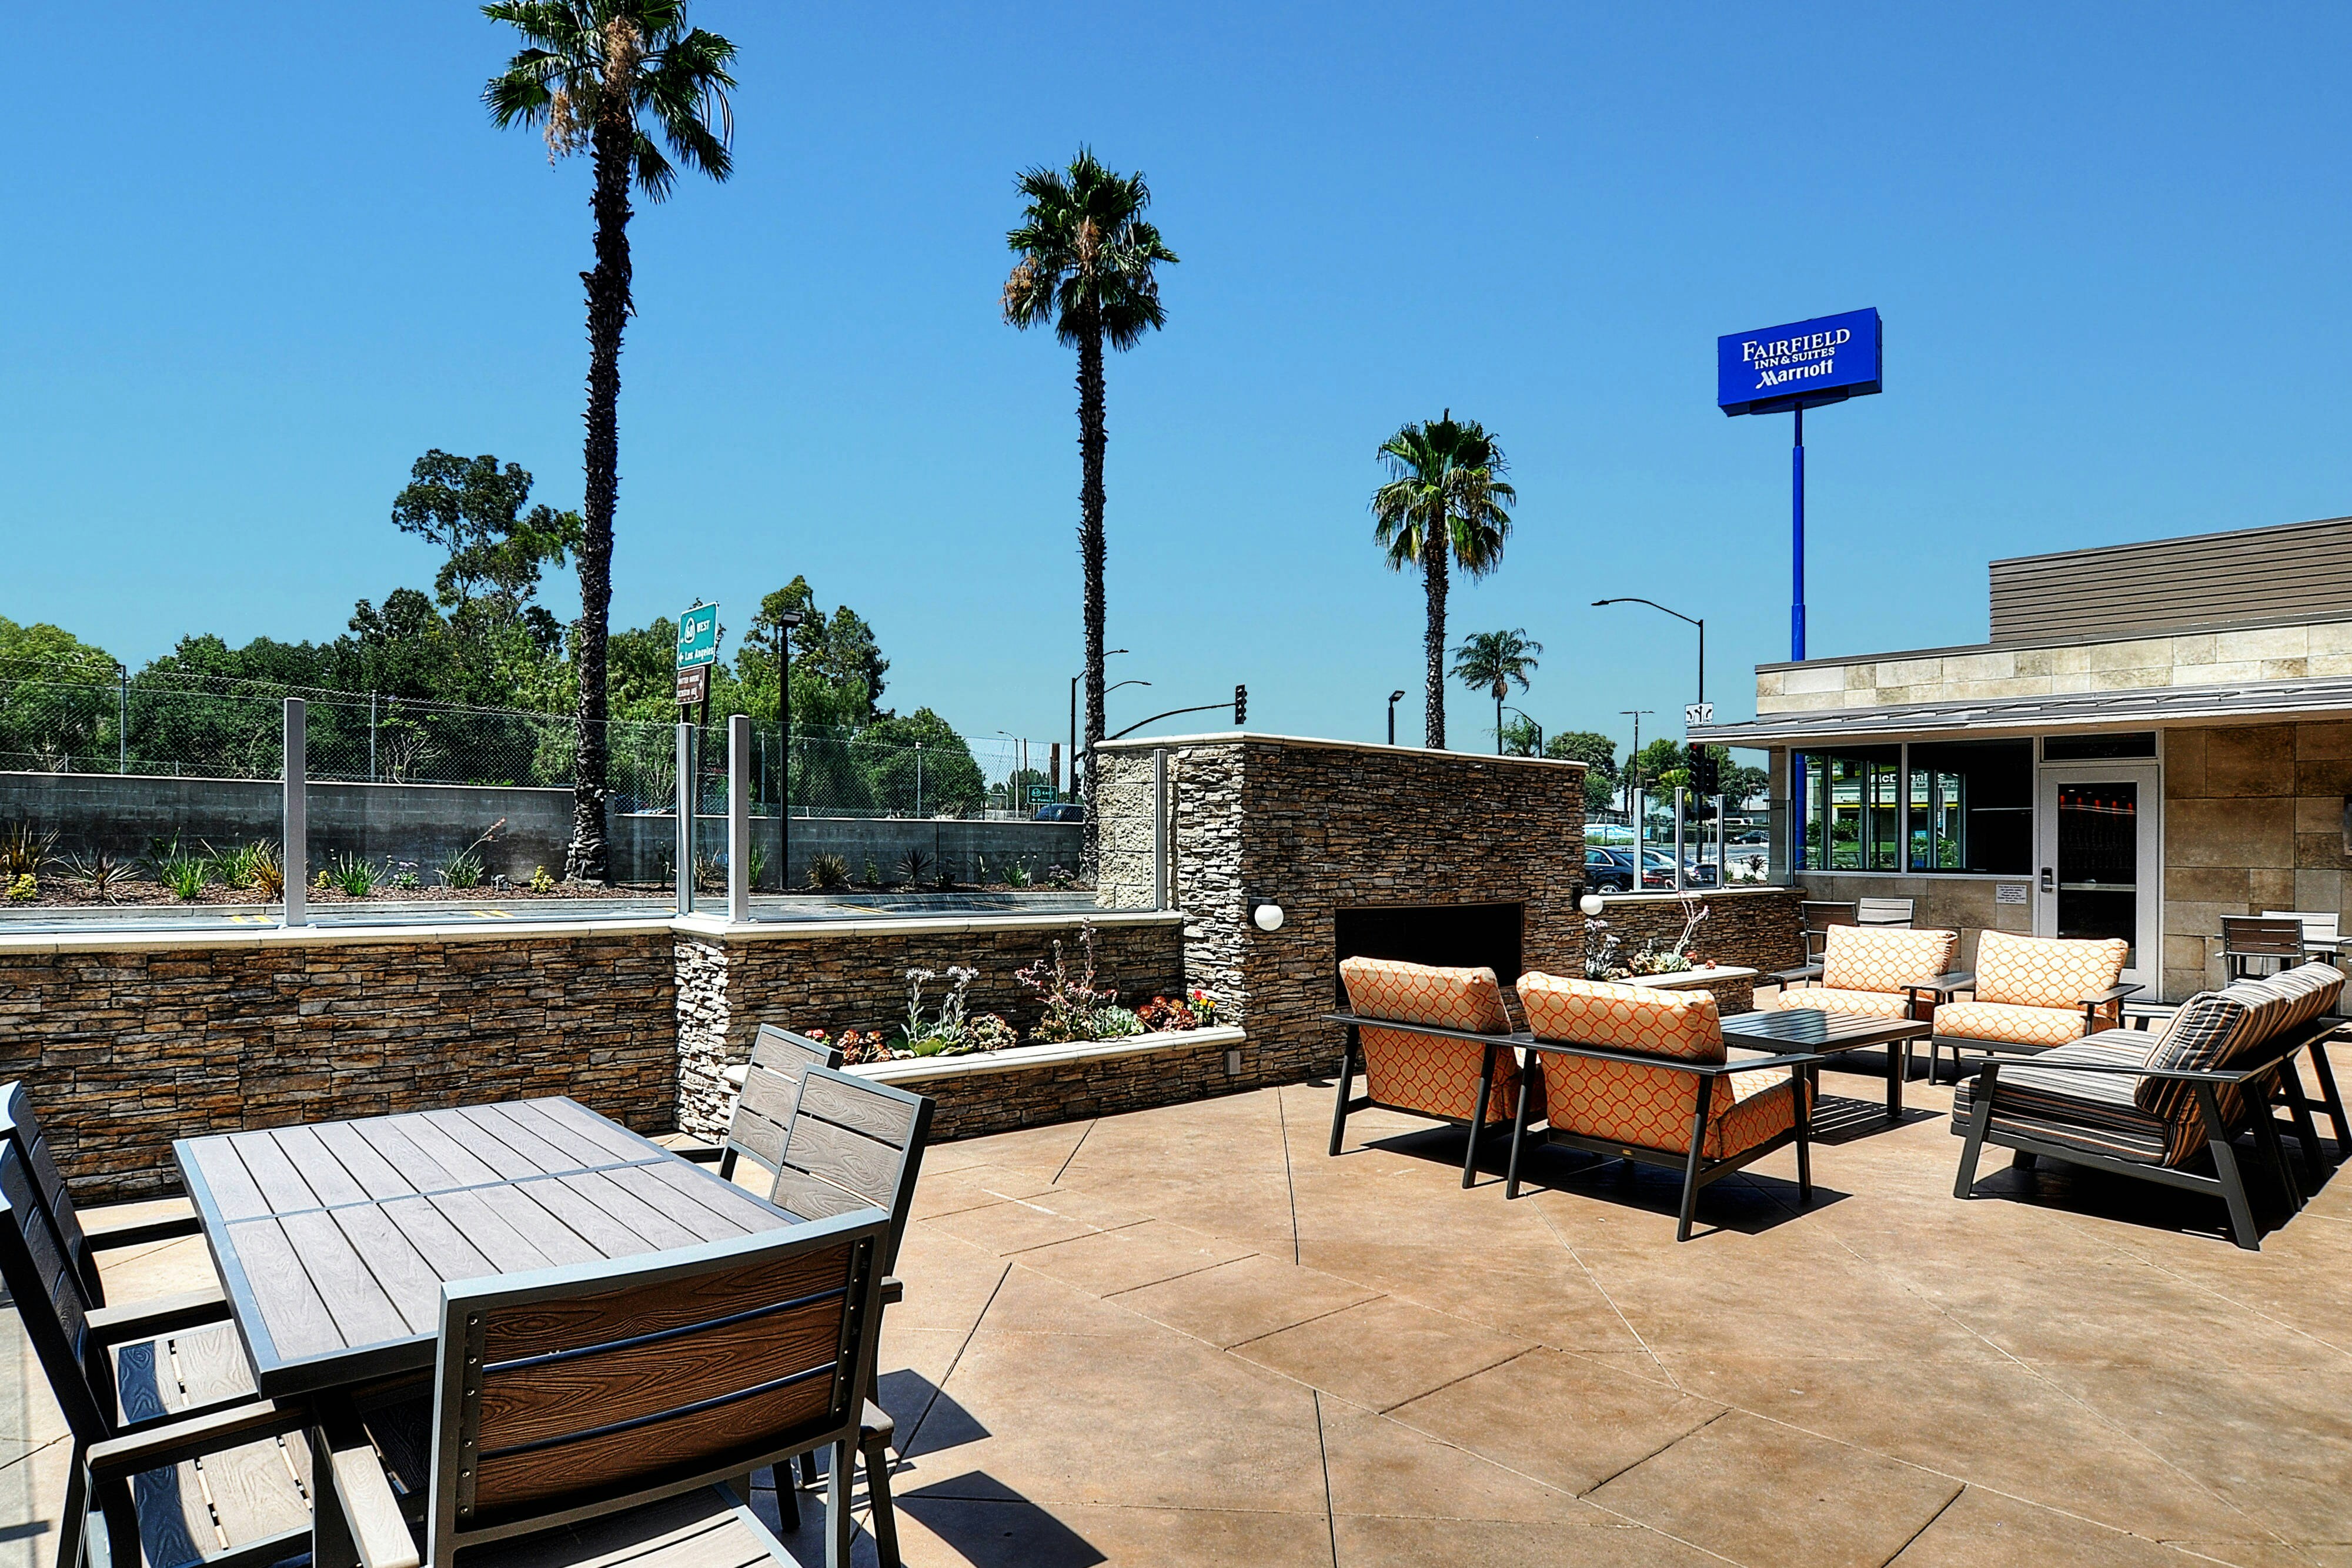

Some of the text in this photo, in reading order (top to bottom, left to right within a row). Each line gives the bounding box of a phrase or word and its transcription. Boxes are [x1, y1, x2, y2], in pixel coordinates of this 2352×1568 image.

[1742, 329, 1850, 362] FAIRFIELD
[1755, 359, 1834, 389] Marriott
[696, 620, 710, 633] WEST
[685, 646, 714, 661] Los Angeles
